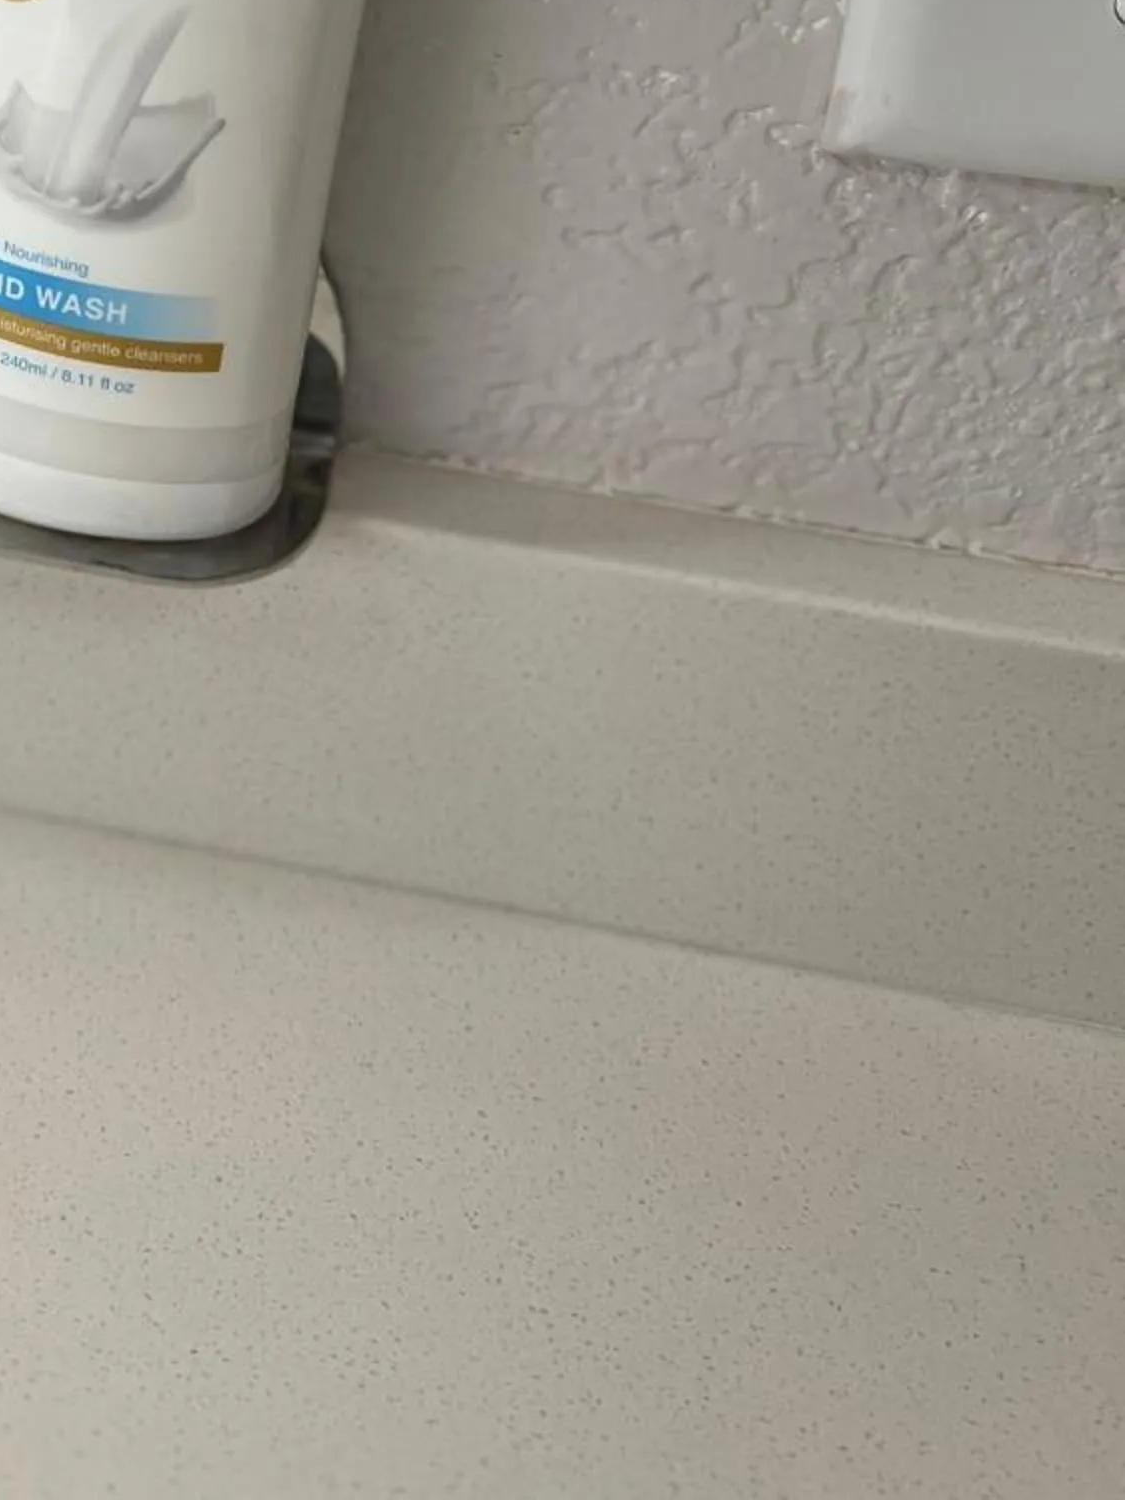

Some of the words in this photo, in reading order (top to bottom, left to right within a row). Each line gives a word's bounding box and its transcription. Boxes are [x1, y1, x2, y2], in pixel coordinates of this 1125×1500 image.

[4, 240, 89, 278] Nourishing
[35, 284, 129, 325] WASH
[71, 338, 121, 358] gentle
[125, 344, 204, 365] cleansers
[0, 351, 48, 376] 240ml
[61, 369, 94, 388] 8.11
[115, 381, 136, 395] oz
